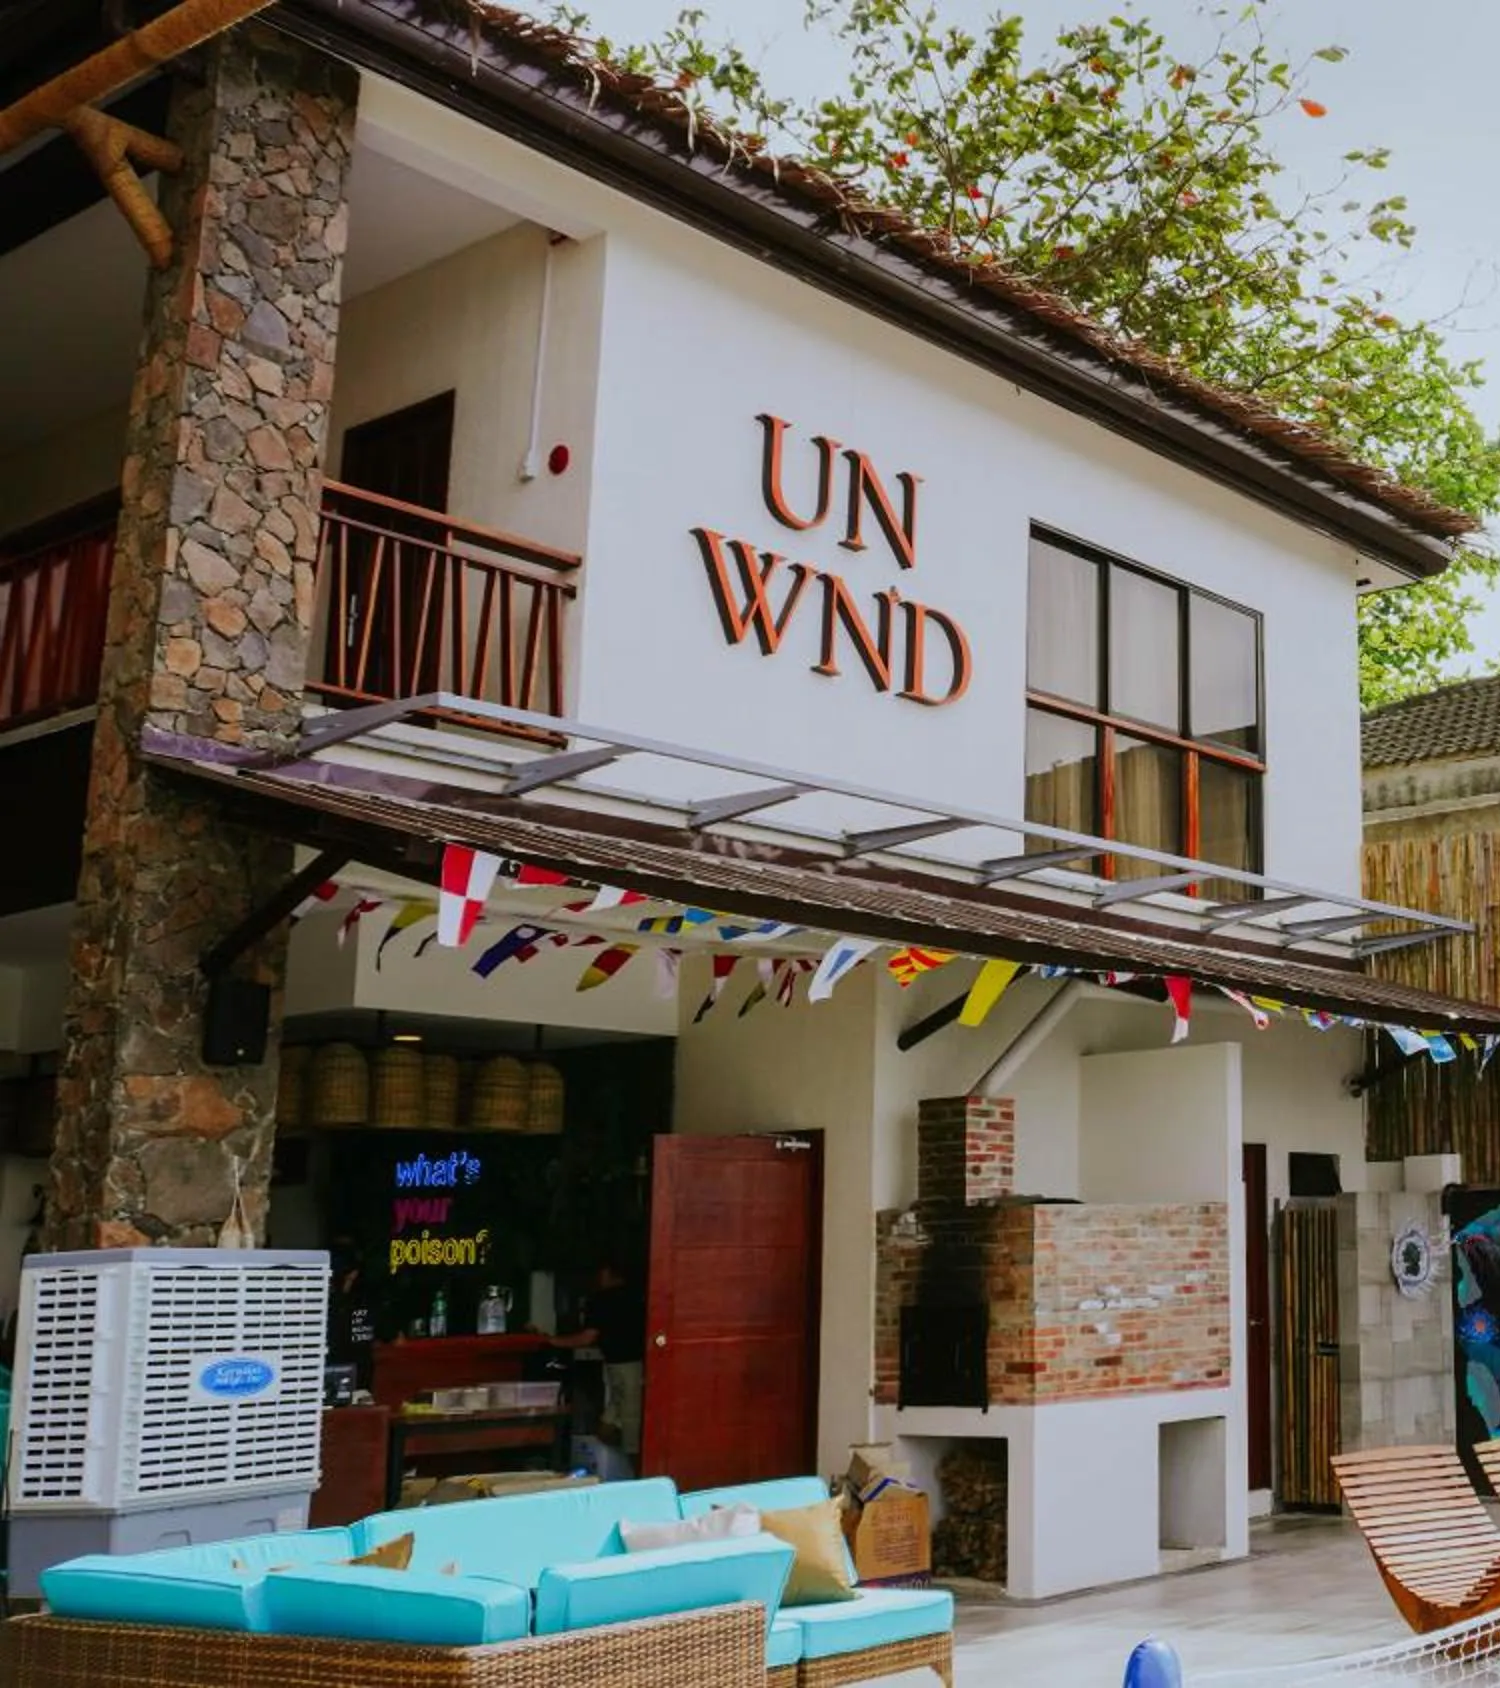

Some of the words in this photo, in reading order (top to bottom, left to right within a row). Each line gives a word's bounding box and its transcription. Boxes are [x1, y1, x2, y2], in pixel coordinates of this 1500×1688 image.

[754, 413, 925, 570] UN
[688, 526, 974, 707] WND
[392, 1197, 454, 1233] your
[396, 1151, 481, 1187] what's
